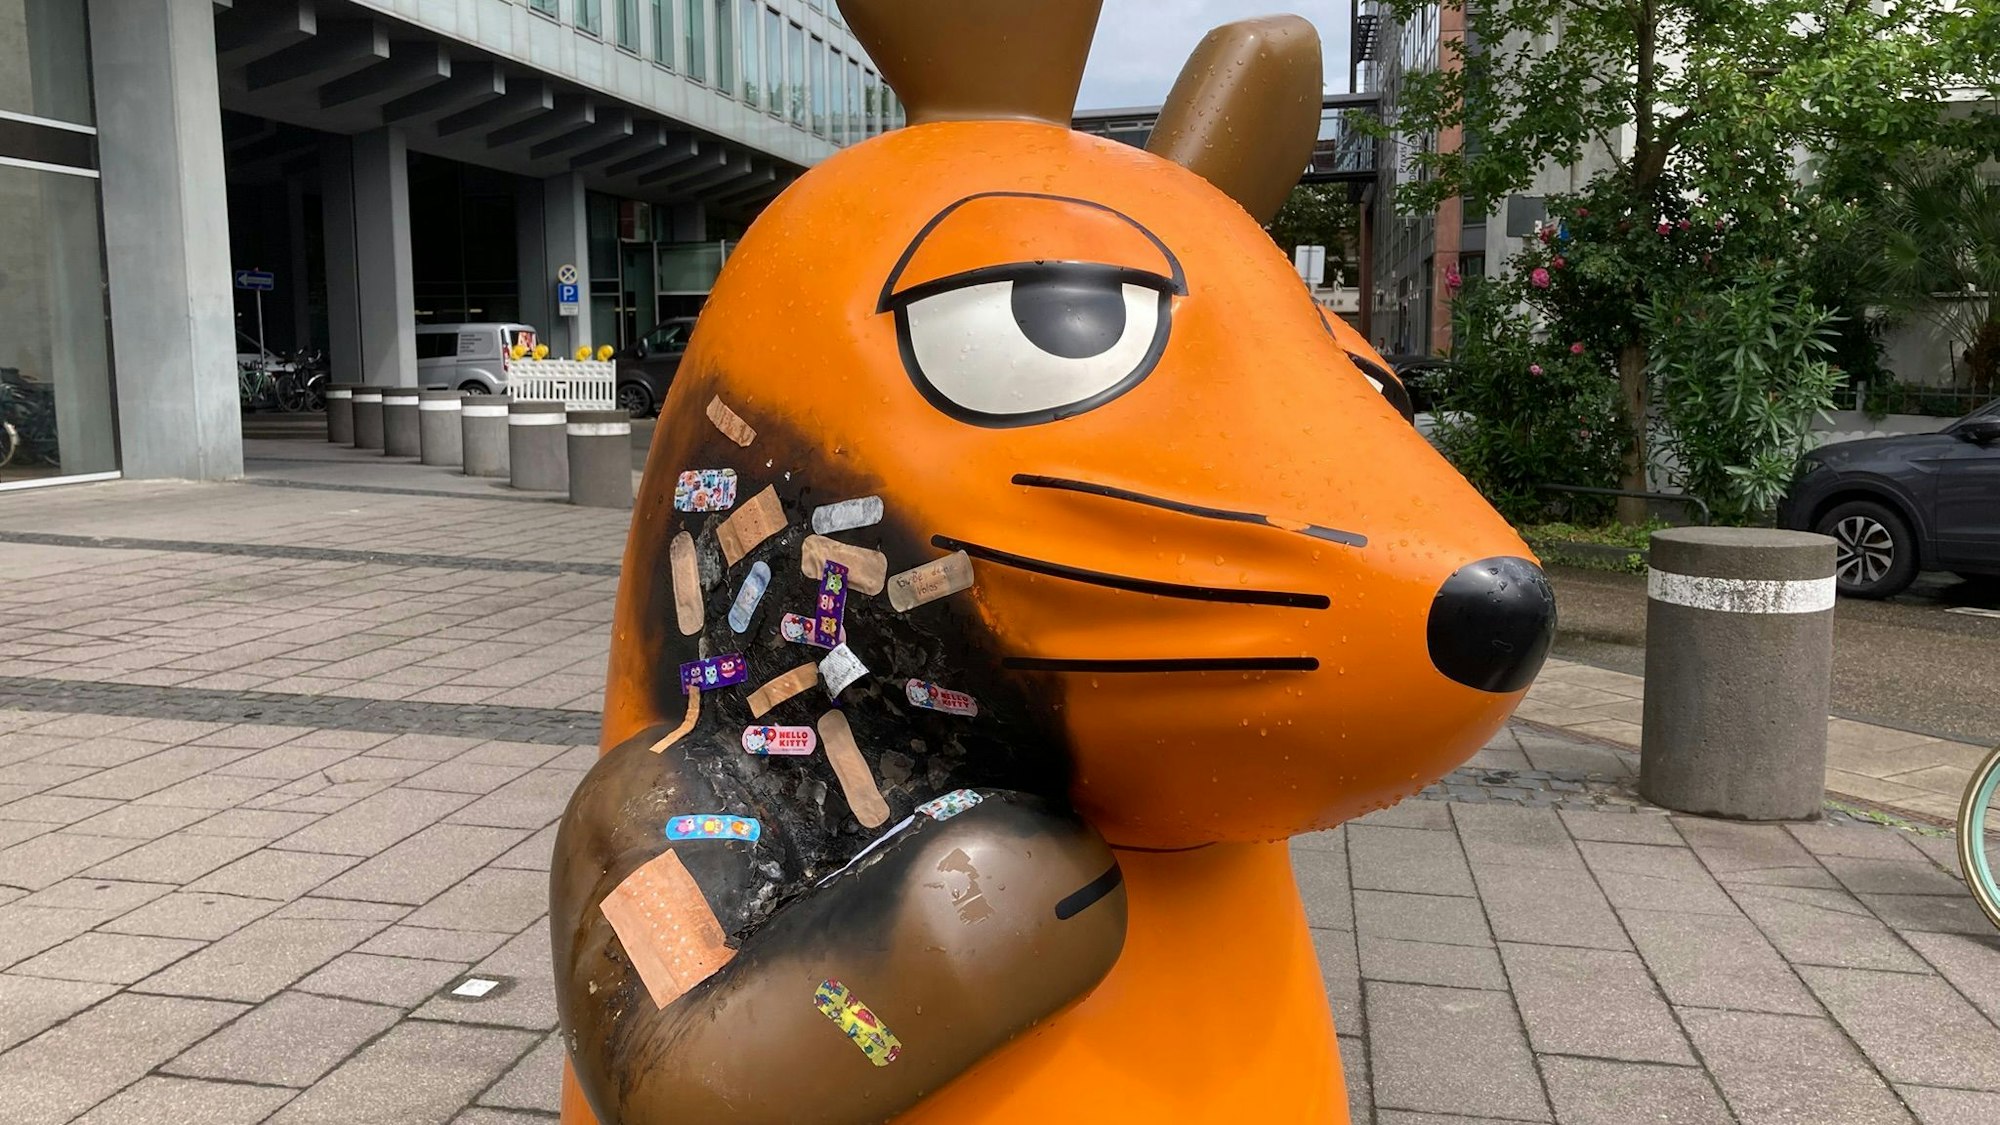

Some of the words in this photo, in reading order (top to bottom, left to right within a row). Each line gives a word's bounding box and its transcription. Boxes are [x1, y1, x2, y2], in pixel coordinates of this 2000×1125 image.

[1398, 146, 1408, 174] Praxis
[564, 286, 574, 301] P
[941, 692, 969, 702] HELLO
[942, 699, 970, 708] KITTY
[779, 731, 808, 739] HELLO
